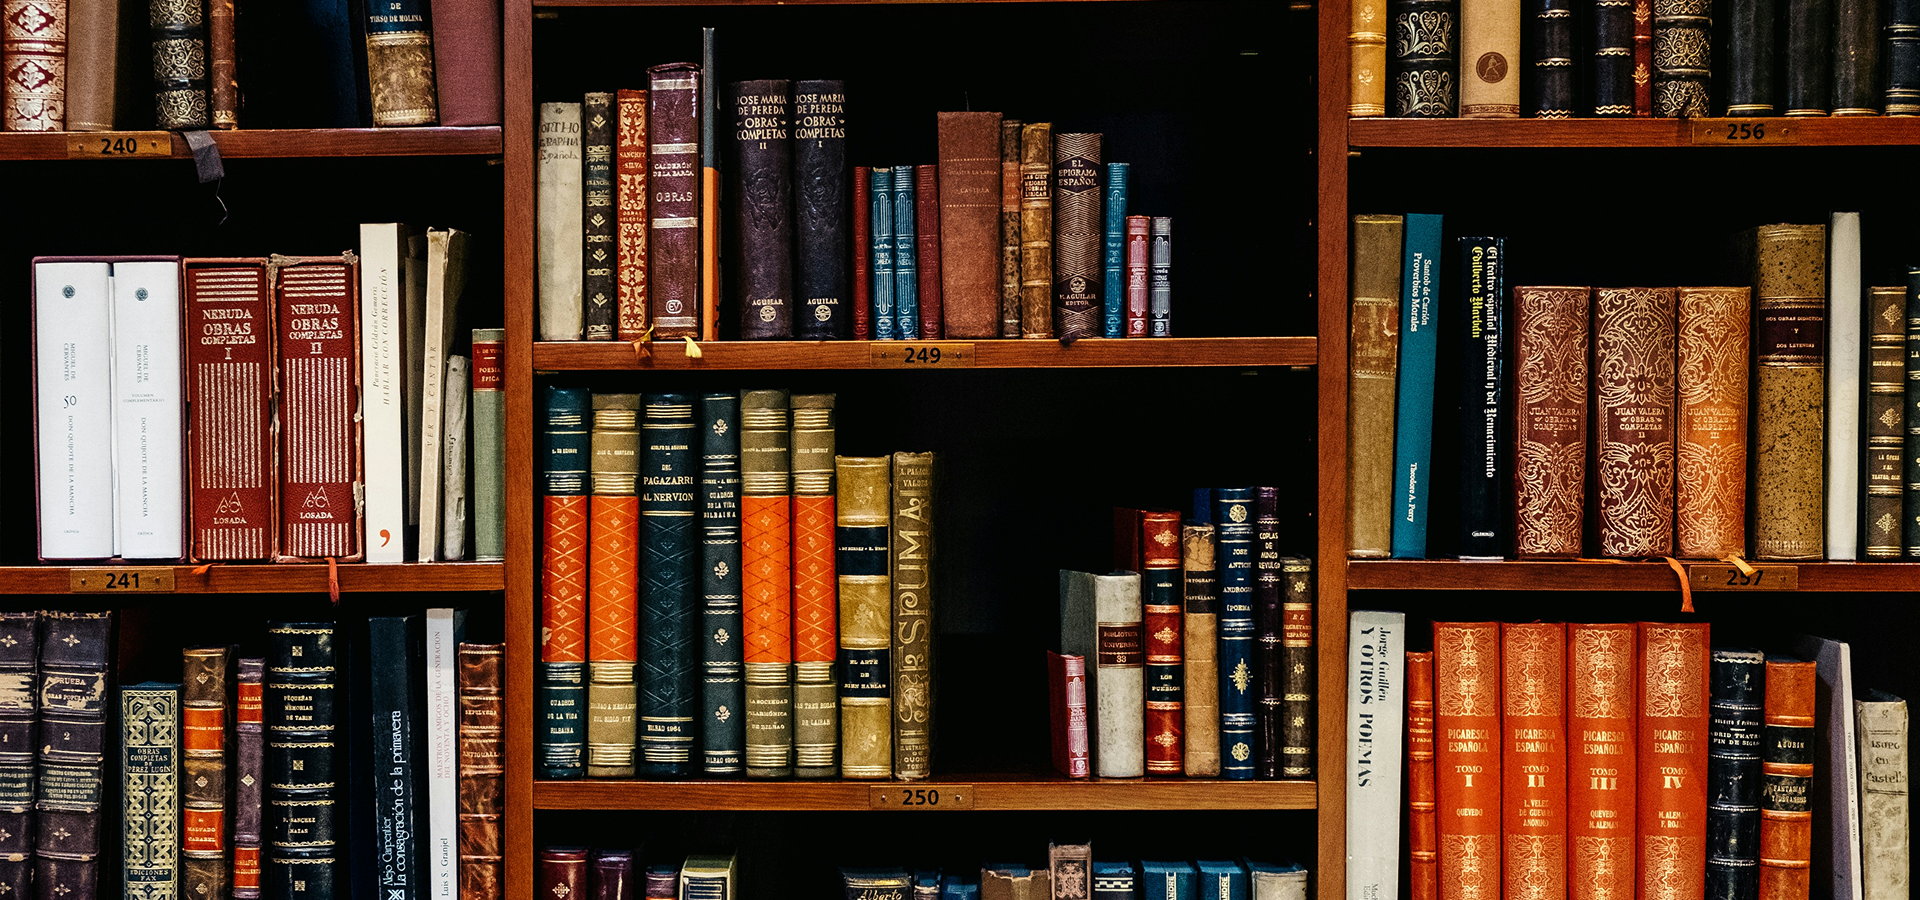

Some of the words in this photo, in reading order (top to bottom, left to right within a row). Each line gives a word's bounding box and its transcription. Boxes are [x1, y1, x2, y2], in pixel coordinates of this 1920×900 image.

[370, 15, 388, 23] TIRSO
[735, 95, 758, 105] JOSE
[760, 95, 787, 104] MARIA
[794, 94, 817, 103] JOSE
[819, 94, 845, 103] MARIA
[738, 106, 748, 115] DE
[752, 105, 785, 115] PEREDA
[797, 105, 807, 113] DE
[810, 104, 843, 113] PEREDA
[745, 117, 778, 128] OBRAS
[803, 116, 836, 127] OBRAS
[736, 129, 787, 140] COMPLETAS
[795, 128, 845, 139] COMPLETAS
[1726, 124, 1765, 140] 256
[101, 138, 137, 154] 240
[1058, 169, 1097, 177] EPIGRAMA
[1058, 177, 1097, 186] ESPAÑOL
[656, 192, 693, 202] OBRAS
[1487, 246, 1498, 259] El
[1412, 252, 1423, 297] Proverbios
[1423, 259, 1431, 285] Santob
[1487, 261, 1497, 291] teatro
[1423, 287, 1431, 295] de
[379, 268, 388, 336] CORRECCIÓN
[202, 309, 253, 320] NERUDA
[290, 304, 340, 315] NERUDA
[1411, 298, 1421, 332] Morales
[1421, 297, 1431, 325] Carrión
[1485, 293, 1497, 331] español
[203, 322, 251, 336] OBRAS
[291, 318, 338, 330] OBRAS
[201, 335, 256, 345] COMPLETAS
[289, 330, 343, 340] COMPLETAS
[225, 347, 232, 360] I
[310, 342, 322, 354] II
[381, 339, 389, 359] CON
[904, 347, 941, 363] 249
[382, 366, 390, 406] HABLAR
[64, 395, 77, 409] 50
[1487, 391, 1497, 405] del
[1639, 407, 1665, 415] VALERA
[1484, 408, 1497, 478] Renacimiento
[69, 463, 74, 473] DE
[142, 465, 147, 475] DE
[69, 475, 74, 484] LA
[142, 477, 148, 485] LA
[643, 476, 693, 485] PAGAZARRI
[1409, 463, 1417, 494] Theodore
[643, 493, 652, 501] AL
[653, 493, 694, 501] NERVION
[1409, 494, 1416, 503] A.
[1407, 504, 1415, 522] Perry
[213, 517, 247, 525] LOSADA
[106, 573, 139, 588] 241
[1361, 627, 1374, 639] Y
[1378, 627, 1391, 657] Jorge
[1359, 644, 1374, 705] OTROS
[436, 681, 442, 689] LA
[1378, 661, 1390, 701] Guillén
[436, 691, 442, 701] DE
[3, 734, 8, 742] 1
[64, 732, 70, 740] 2
[390, 710, 406, 763] primavera
[1448, 729, 1489, 739] PICARESCA
[1515, 729, 1555, 739] PICARESCA
[1584, 731, 1625, 741] PICARESCA
[1654, 730, 1695, 740] PICARESCA
[1358, 713, 1374, 788] POEMAS
[1448, 741, 1488, 752] ESPAÑOLA
[1515, 741, 1554, 752] ESPAÑOLA
[1584, 743, 1623, 754] ESPAÑOLA
[1654, 742, 1693, 753] ESPAÑOLA
[128, 765, 150, 773] PÉREZ
[151, 765, 171, 773] LUGÍN
[390, 767, 402, 776] la
[1455, 765, 1483, 773] TOMO
[1590, 768, 1618, 776] TOMO
[1660, 767, 1687, 775] TOMO
[1465, 775, 1473, 787] I
[1527, 775, 1545, 787] II
[1590, 777, 1617, 790] III
[1663, 776, 1686, 789] IV
[390, 779, 403, 796] de
[903, 790, 939, 805] 250
[1457, 808, 1483, 817] QUEVEDO
[1590, 810, 1617, 818] QUEVEDO
[382, 817, 395, 863] Carpentier
[392, 799, 409, 871] consagración
[440, 837, 450, 866] Granjel
[383, 865, 395, 886] Alejo
[858, 889, 902, 900] Alberto
